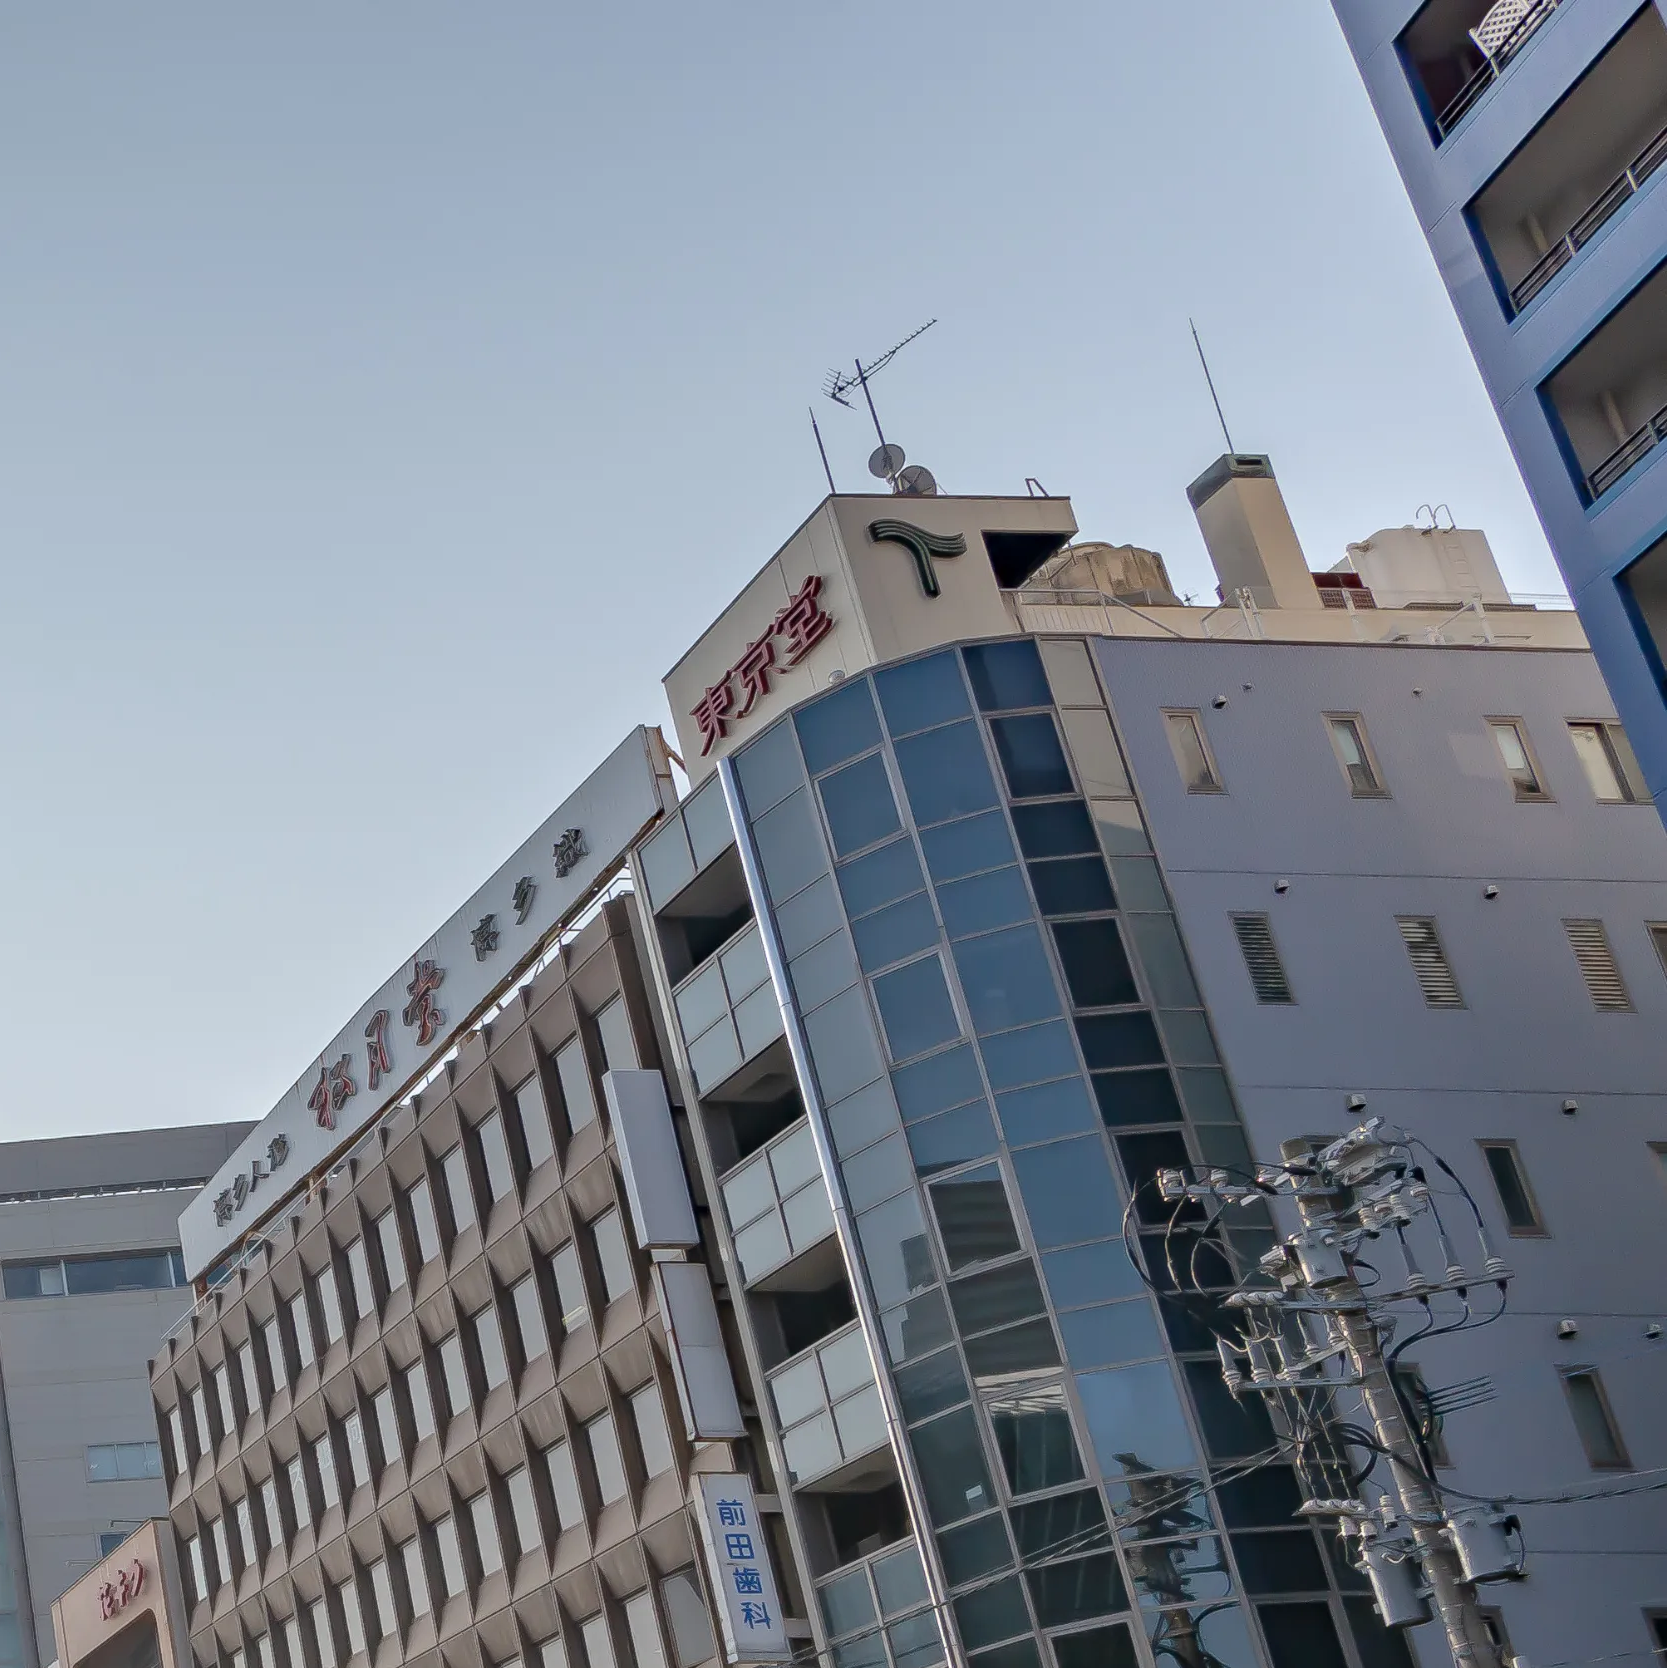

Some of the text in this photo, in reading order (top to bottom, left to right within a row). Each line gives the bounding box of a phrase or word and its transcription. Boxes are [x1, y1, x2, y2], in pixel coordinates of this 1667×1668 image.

[689, 574, 834, 757] 東京堂
[715, 1498, 772, 1630] 前田歯科
